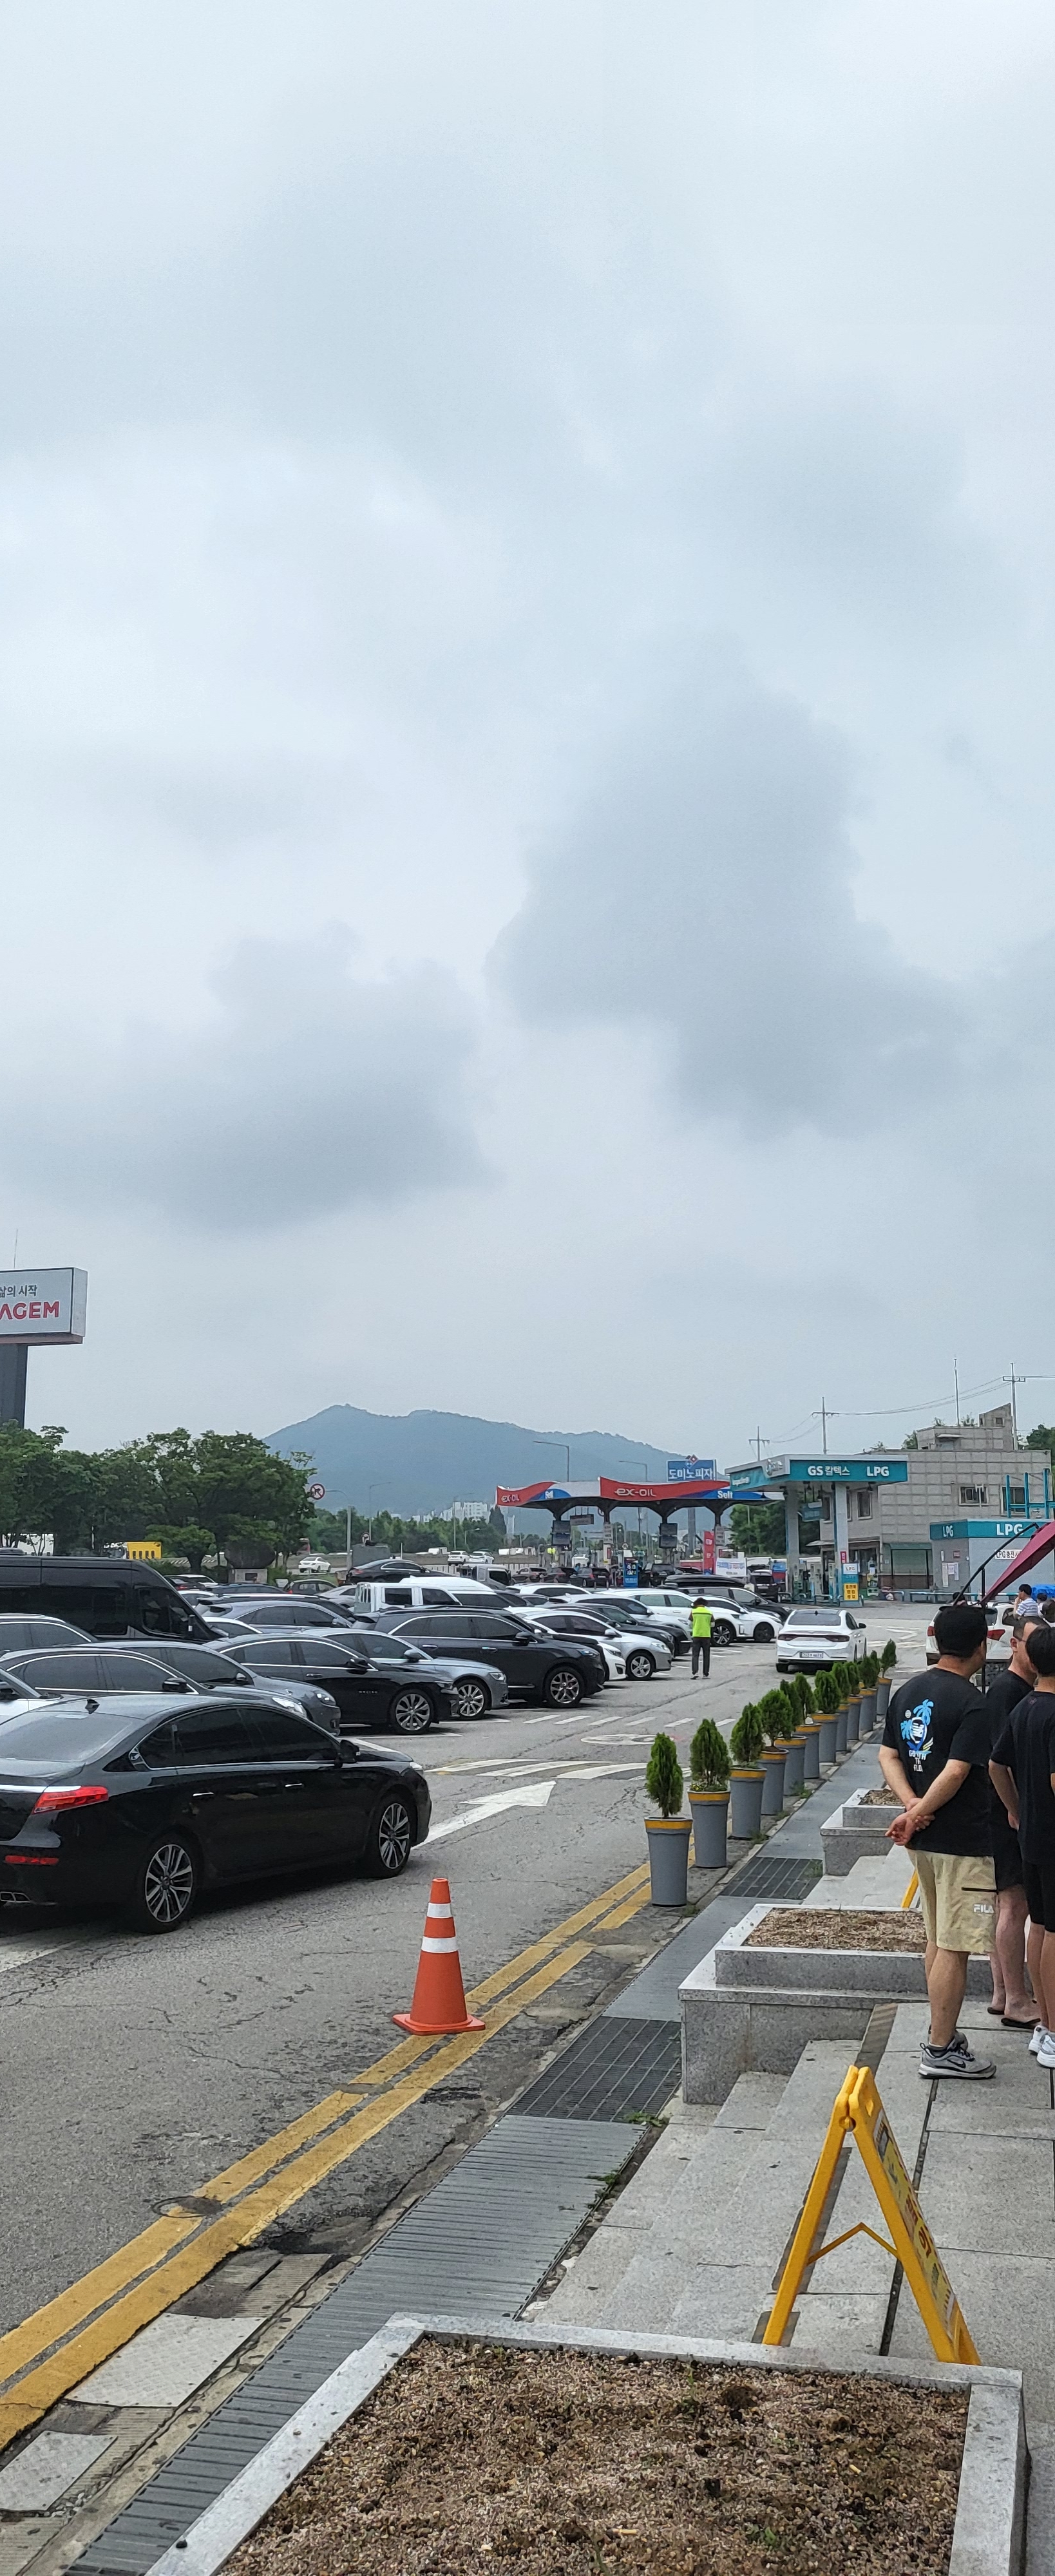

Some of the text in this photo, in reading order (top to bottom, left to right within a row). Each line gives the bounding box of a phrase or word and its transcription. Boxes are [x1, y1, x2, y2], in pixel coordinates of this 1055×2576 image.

[18, 1284, 38, 1297] 시작
[669, 1468, 713, 1481] 도미노피자
[866, 1466, 889, 1477] LPG
[718, 1490, 733, 1499] Self
[943, 1525, 954, 1537] LPG
[996, 1524, 1024, 1536] LPG
[974, 1904, 994, 1913] FILA
